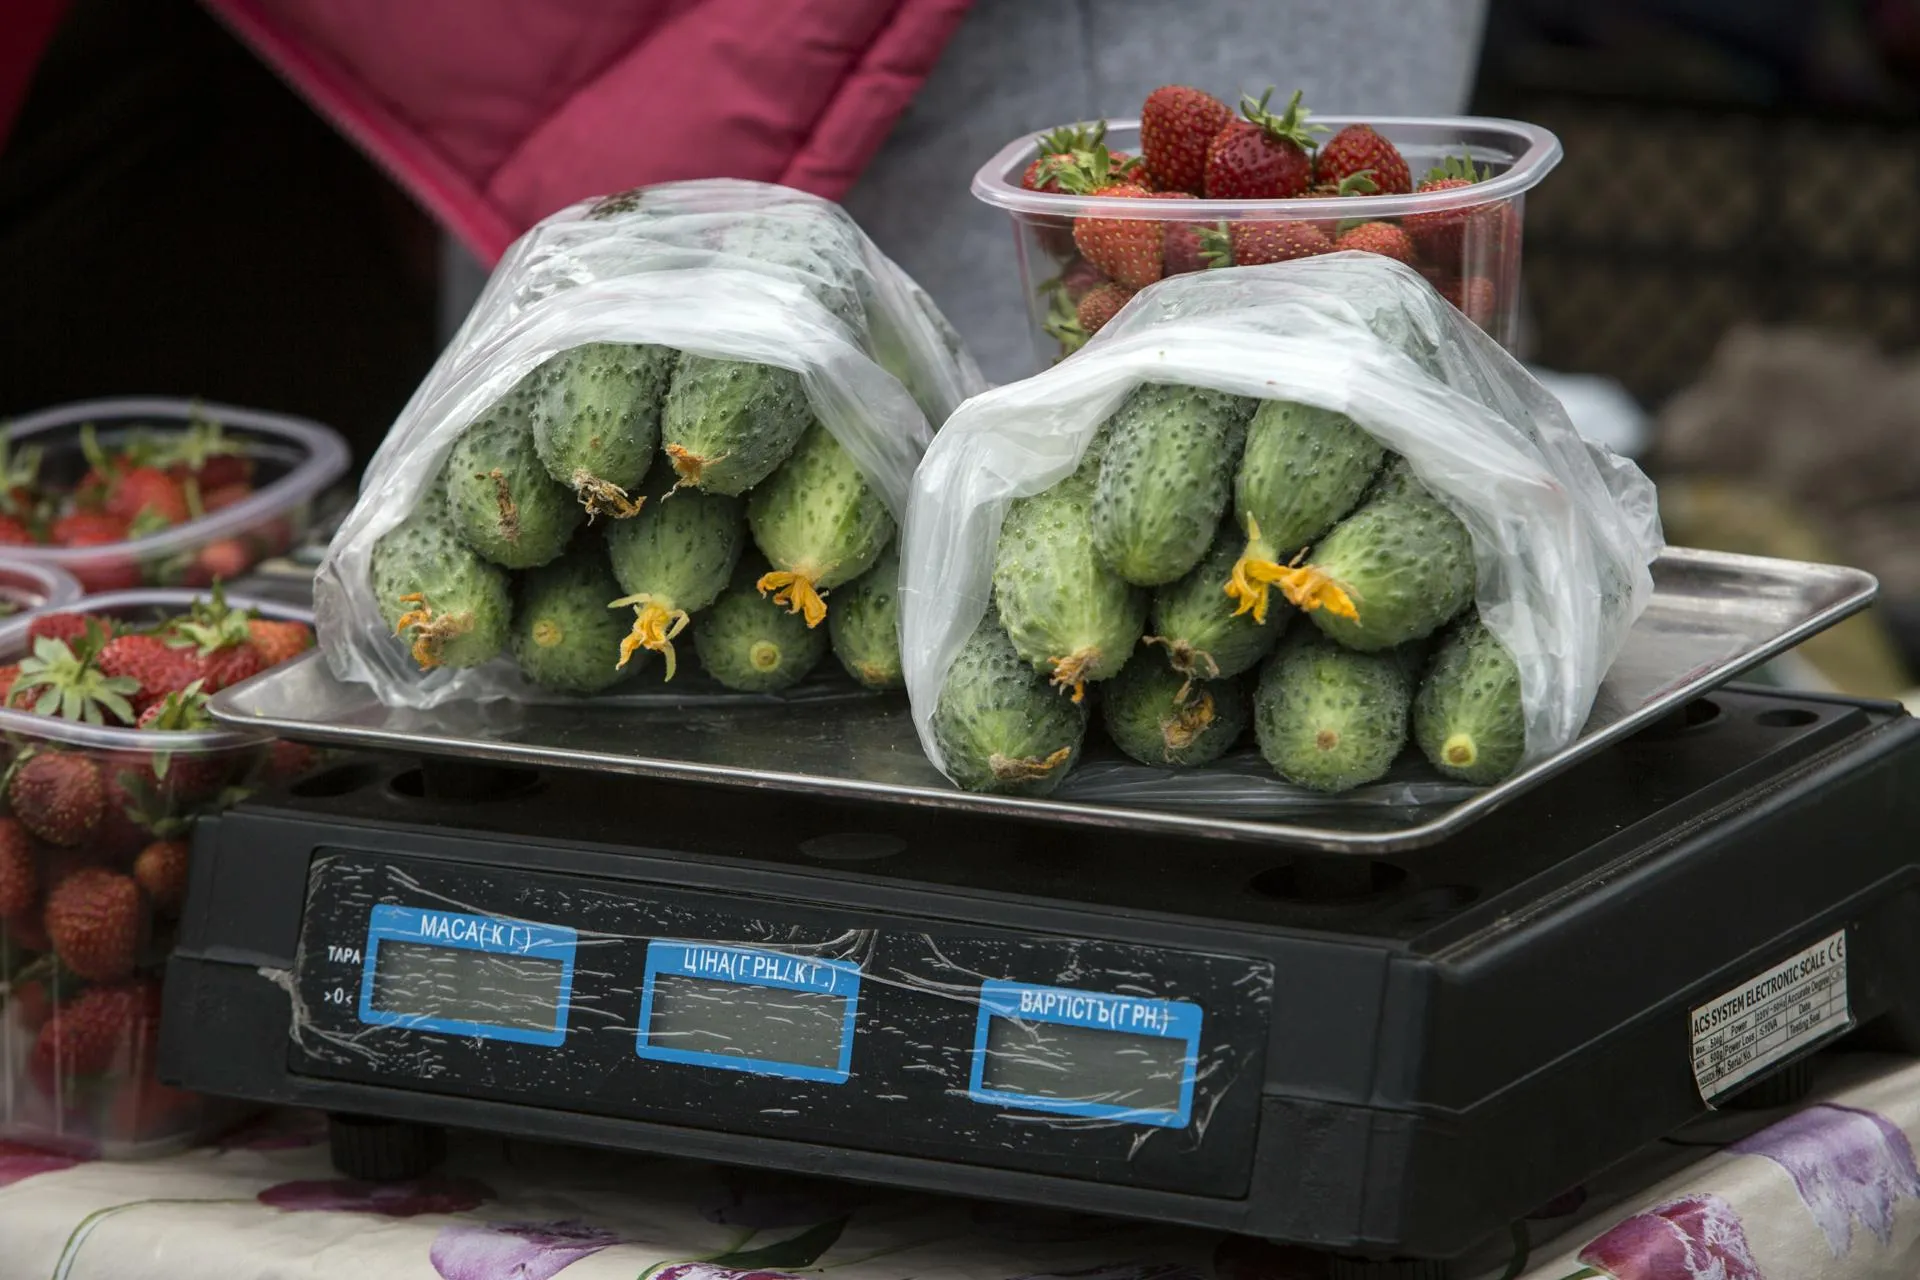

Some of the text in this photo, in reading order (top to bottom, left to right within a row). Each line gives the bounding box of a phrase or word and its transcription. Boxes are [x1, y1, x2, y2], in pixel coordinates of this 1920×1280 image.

[327, 945, 362, 965] ТАРА
[1694, 1012, 1711, 1037] ACS
[1710, 993, 1745, 1027] SYSTEM
[1745, 963, 1800, 1008] ELECTRONIC
[1799, 949, 1826, 978] SCALE
[1798, 1001, 1812, 1015] Date
[1730, 1020, 1747, 1037] Power
[1725, 1032, 1755, 1057] Power Loss
